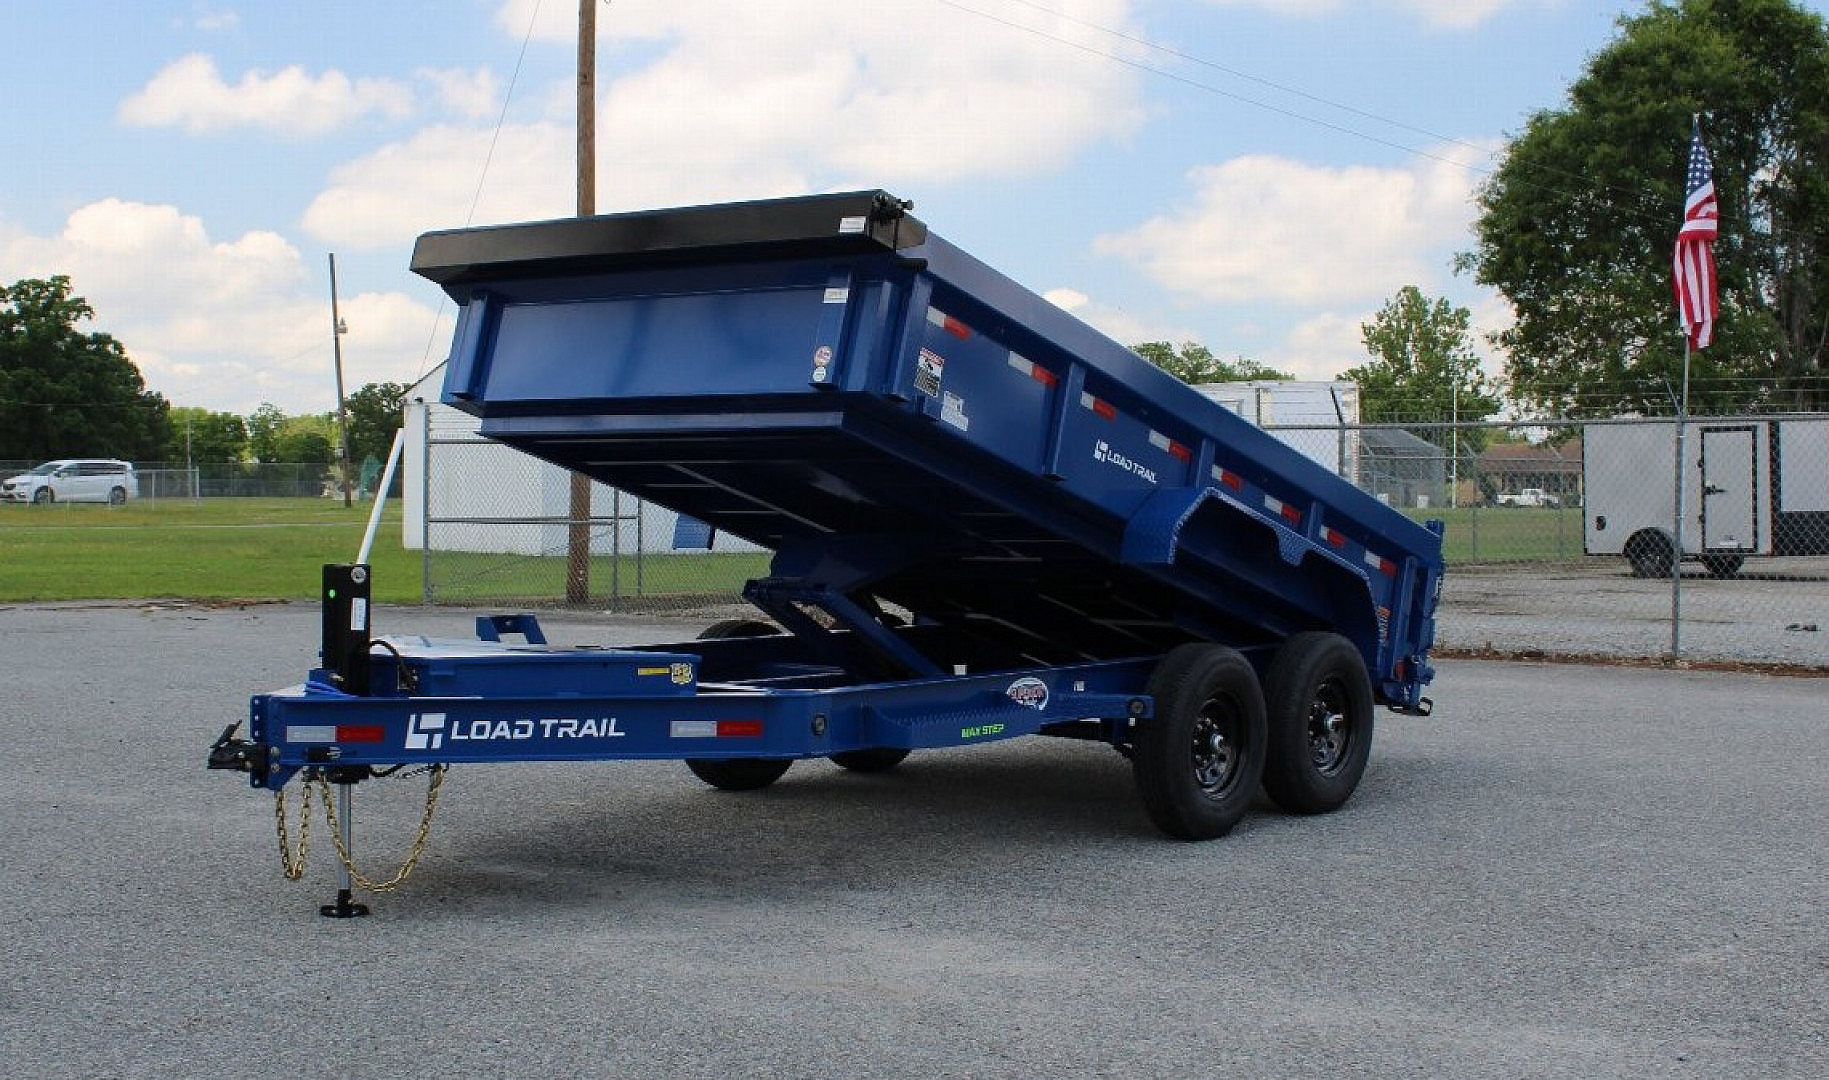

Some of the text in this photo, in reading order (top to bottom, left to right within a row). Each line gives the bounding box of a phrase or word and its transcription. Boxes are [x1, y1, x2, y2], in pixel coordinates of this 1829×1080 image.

[1107, 449, 1133, 471] LOAD
[1133, 462, 1158, 484] TRAIL
[451, 720, 535, 740] LOAD
[540, 717, 626, 738] TRAIL
[982, 723, 1004, 735] STEP
